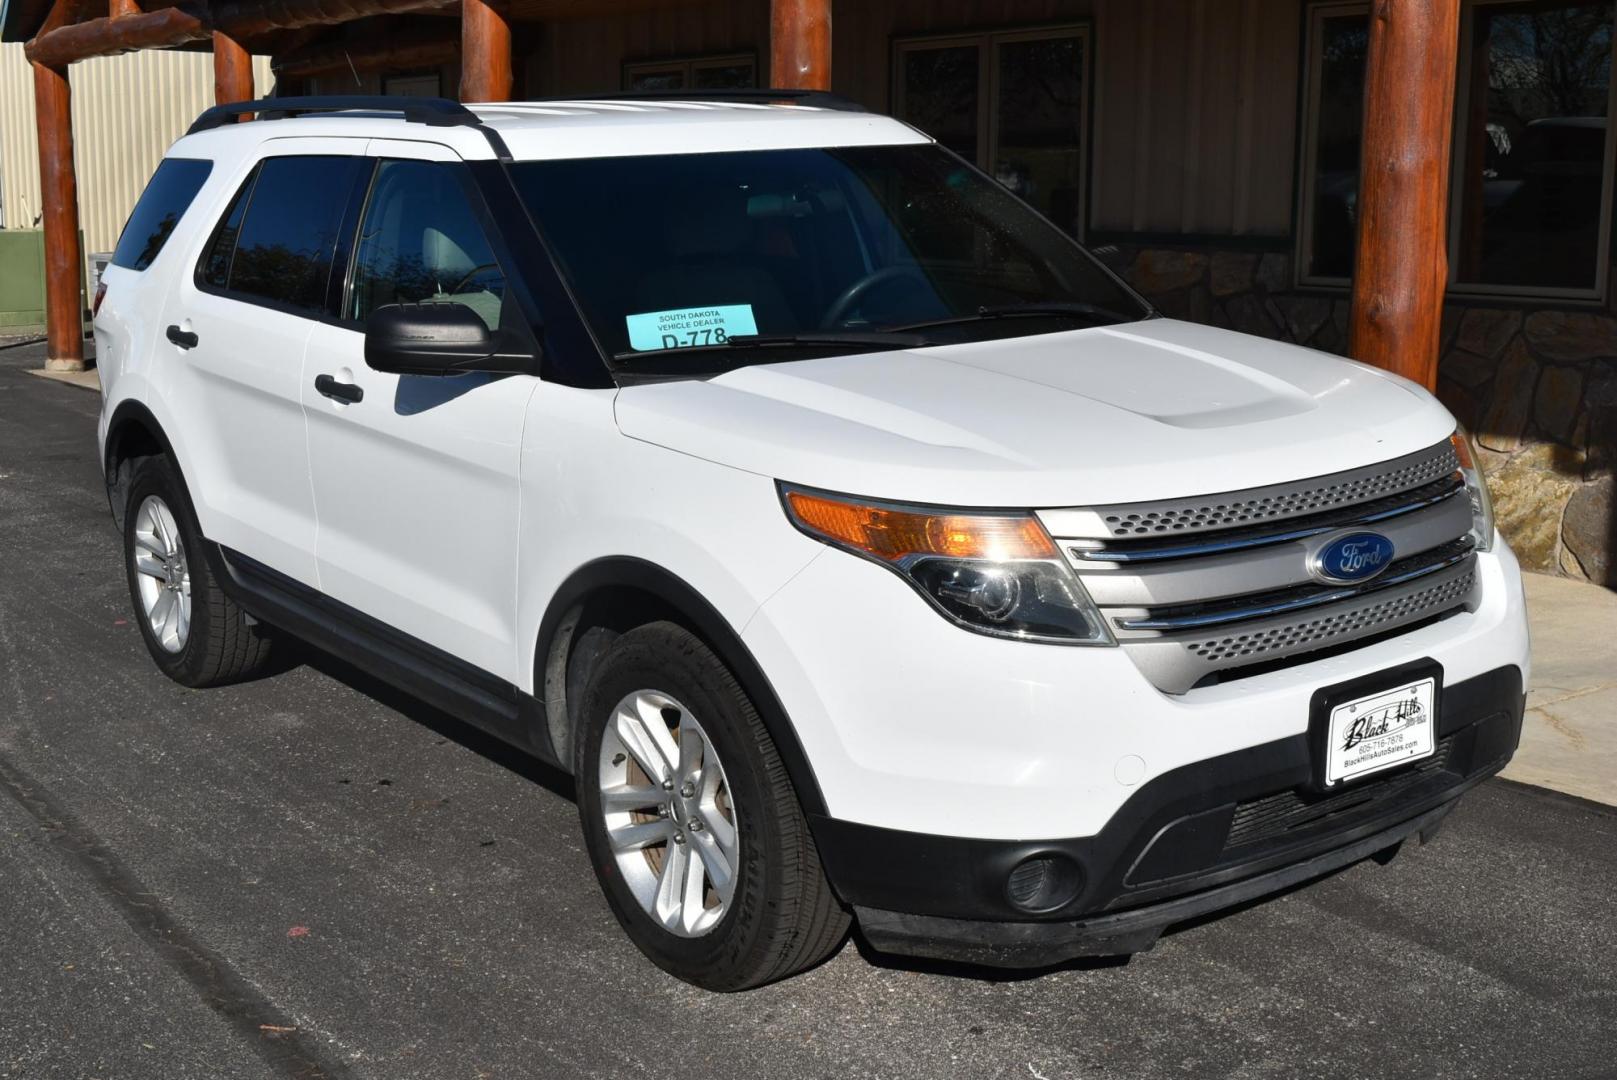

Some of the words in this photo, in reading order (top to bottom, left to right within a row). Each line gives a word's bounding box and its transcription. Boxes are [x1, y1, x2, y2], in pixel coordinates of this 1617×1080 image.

[657, 321, 692, 331] VEHICLE
[693, 318, 725, 327] DEALER
[659, 313, 687, 323] SOUTH
[688, 310, 720, 319] DAKOTA
[661, 327, 727, 349] D-778
[1340, 541, 1381, 572] Ford
[1337, 709, 1389, 752] Black
[1395, 696, 1421, 723] Hills
[1343, 740, 1418, 768] BlackHillsAutoSales.com
